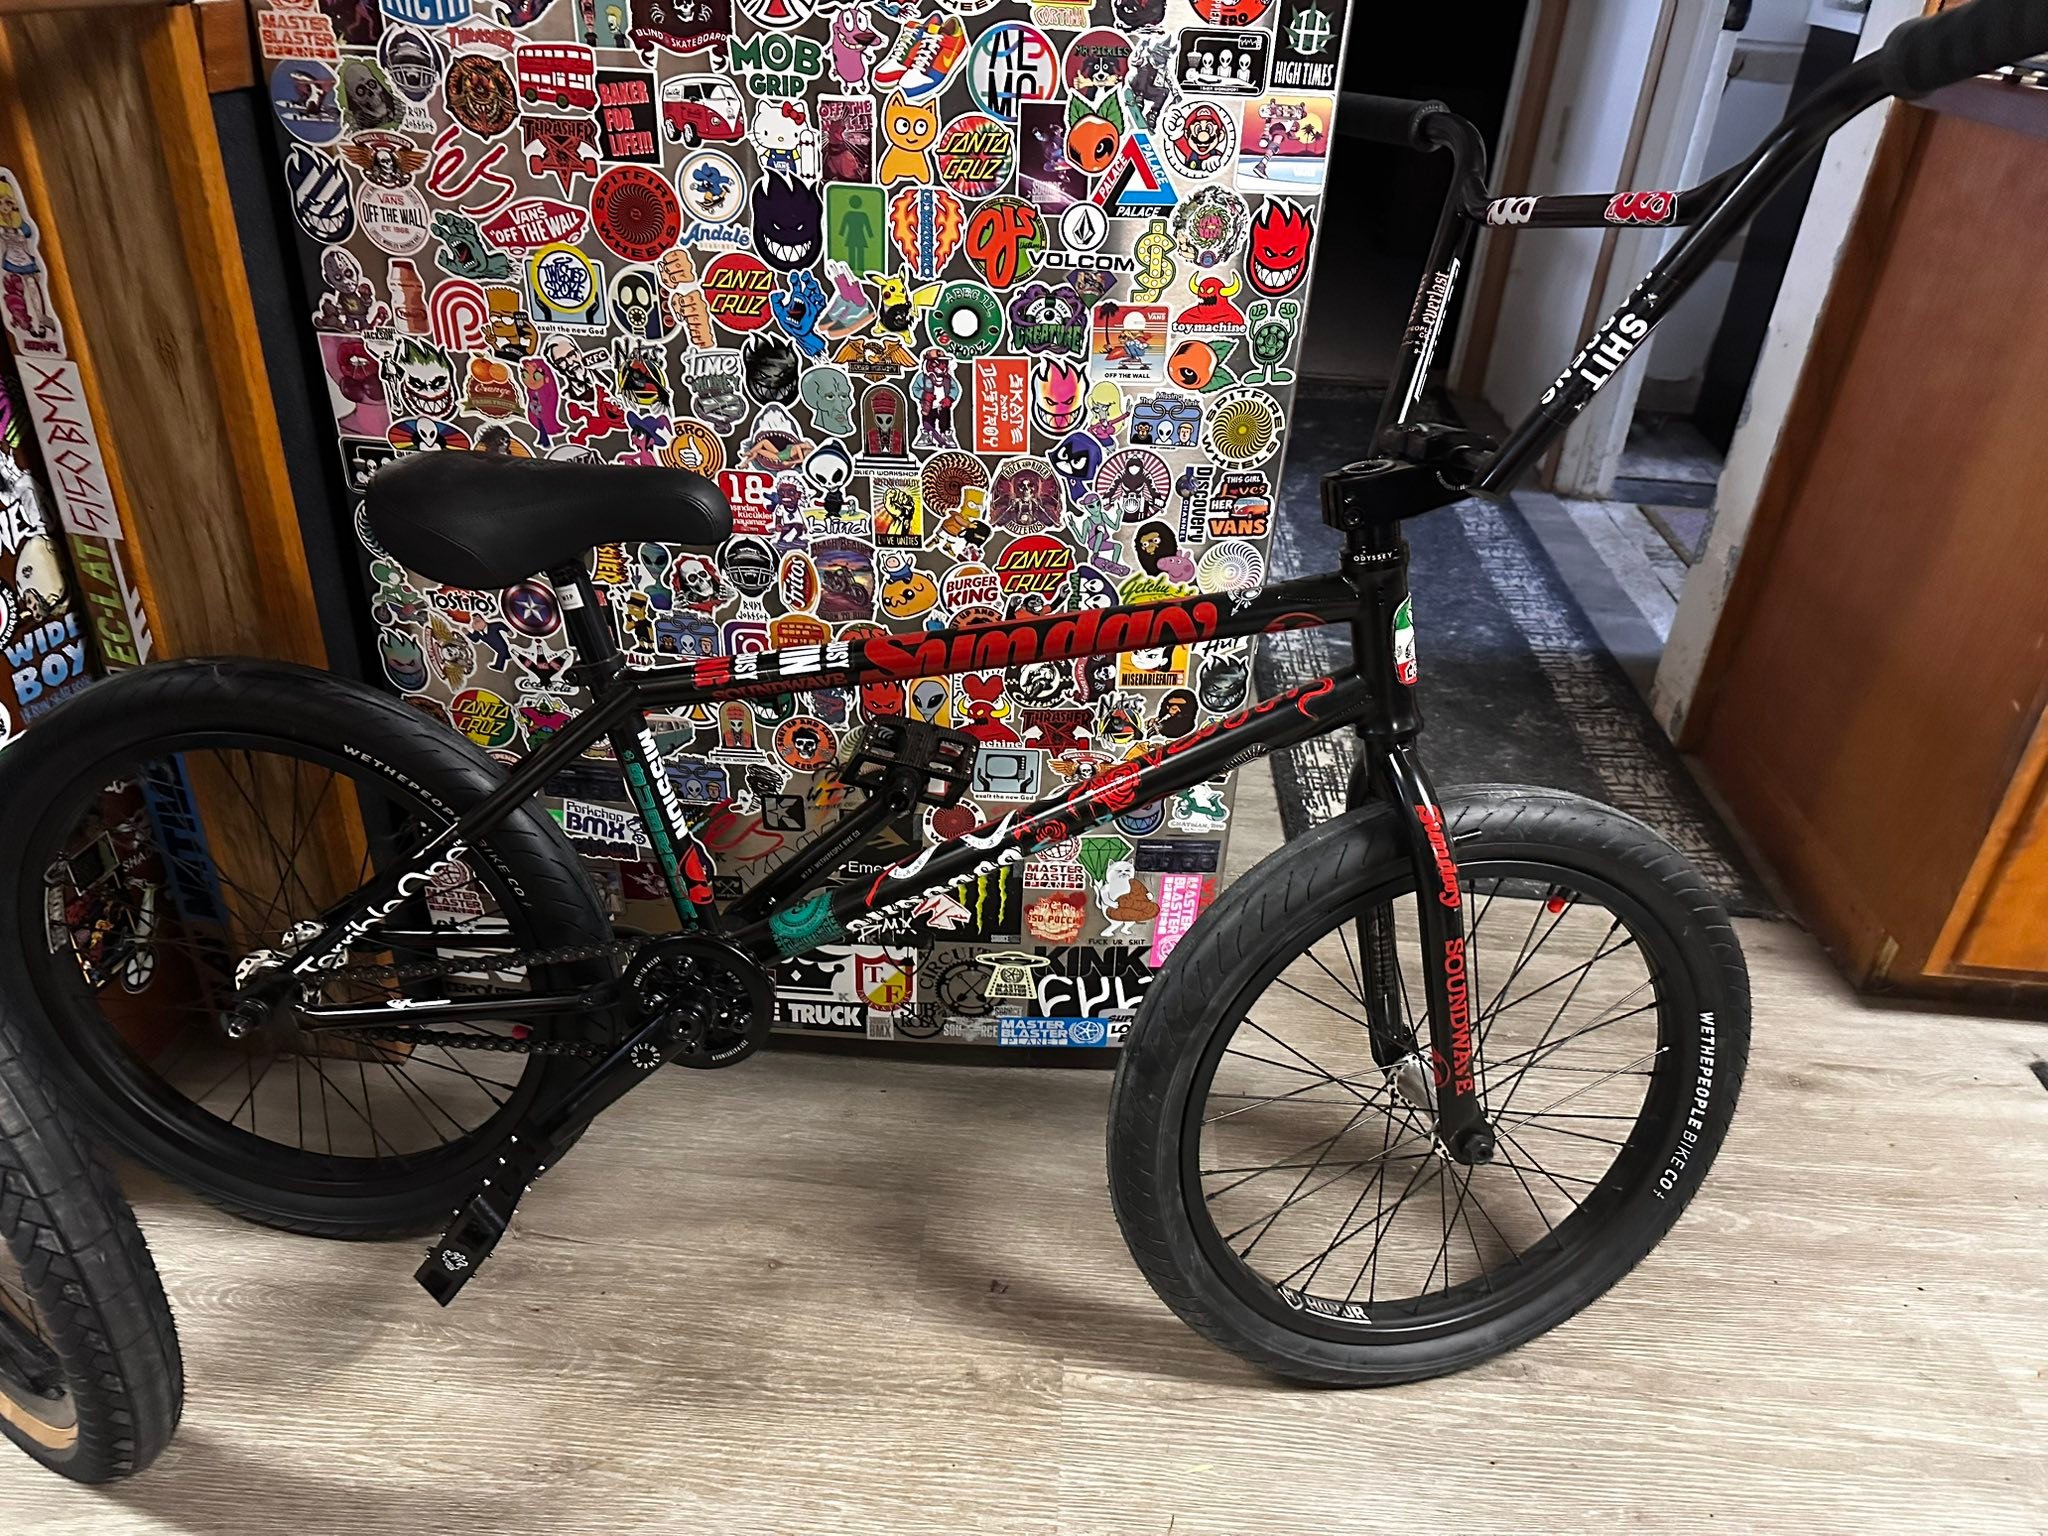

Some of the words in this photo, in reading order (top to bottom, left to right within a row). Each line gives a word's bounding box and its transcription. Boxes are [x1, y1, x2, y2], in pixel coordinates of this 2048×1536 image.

[261, 14, 331, 31] MASTER
[263, 29, 335, 47] BLASTER
[448, 27, 515, 50] THRASHER
[636, 29, 663, 40] BLIND
[731, 34, 822, 76] MOB
[1075, 45, 1089, 57] MR
[1092, 46, 1130, 57] PICKLES
[750, 73, 806, 97] GRIP
[1274, 60, 1302, 85] HIGH
[1303, 61, 1334, 87] TIMES
[601, 80, 649, 106] BAKER
[604, 107, 635, 132] FOR
[819, 102, 842, 118] OFF
[849, 100, 873, 117] THE
[521, 117, 597, 149] THRASHER
[609, 131, 654, 157] LIFE!!!
[937, 132, 1011, 154] SANTA
[943, 159, 1003, 180] CRUZ
[1141, 142, 1169, 186] PALACE
[1099, 153, 1128, 199] PALACE
[377, 194, 405, 206] VANS
[596, 170, 677, 215] SPITFIRE
[362, 202, 379, 223] OFF
[380, 204, 399, 223] THE
[400, 207, 426, 229] WALL
[508, 202, 548, 225] VANS
[1116, 206, 1160, 217] PALACE
[517, 220, 550, 243] THE
[545, 211, 581, 239] WALL
[681, 223, 750, 247] Andalé
[601, 223, 677, 258] WHEELS
[1030, 250, 1135, 273] VOLCOM
[702, 269, 776, 290] SANTA
[710, 294, 771, 316] CRUZ
[945, 288, 980, 304] ABEC
[1422, 270, 1450, 326] everlast
[1147, 312, 1166, 321] VANS
[363, 331, 394, 342] JACKSON
[537, 325, 556, 333] exalt
[557, 325, 570, 333] the
[588, 327, 605, 336] God
[1014, 323, 1084, 353] CREATURE
[585, 351, 607, 367] KFC
[1580, 313, 1648, 392] SHIT
[475, 383, 512, 399] Orange
[1156, 391, 1184, 401] Missing
[978, 363, 999, 447] DESTROY
[1009, 374, 1024, 444] SKATE
[1205, 389, 1283, 430] SPITFIRE
[675, 423, 706, 439] BRO
[1202, 434, 1278, 470] WHEELS
[1006, 462, 1021, 475] ROCK
[1031, 462, 1050, 476] RIDER
[1226, 475, 1244, 483] THIS
[1244, 474, 1261, 483] GIRL
[728, 473, 764, 505] 18
[1212, 499, 1234, 511] HER
[807, 515, 868, 536] blind
[1007, 520, 1043, 536] MOTEROS
[1179, 499, 1190, 543] CHANNEL
[1210, 519, 1267, 536] VANS
[896, 536, 920, 546] UNITES
[996, 548, 1071, 571] SANTA
[1353, 551, 1393, 562] ODYSSEY
[783, 555, 807, 608] Fritos
[946, 576, 998, 593] BURGER
[1003, 571, 1064, 593] CRUZ
[948, 587, 999, 608] KING
[974, 607, 996, 618] AND
[4, 611, 83, 669] WIDE
[12, 637, 87, 705] BOY
[1121, 672, 1178, 687] MISERABLEFAITH
[712, 671, 848, 701] SOUNDWAVE
[450, 699, 511, 720] SANTA
[459, 717, 506, 736] CRUZ
[1023, 709, 1095, 735] THRASHER
[776, 727, 786, 750] SHUT
[801, 718, 819, 726] AND
[820, 724, 835, 750] SKATE
[980, 739, 1023, 749] achine
[343, 744, 463, 823] WETHEPEOP
[1020, 793, 1034, 801] God
[566, 800, 624, 823] Porkchop
[566, 815, 626, 841] BMX
[1414, 803, 1460, 909] Sunday
[1025, 872, 1085, 882] BLASTER
[1026, 863, 1084, 873] MASTER
[1166, 876, 1187, 935] BLASTER
[1181, 876, 1198, 933] MASTER
[1088, 938, 1109, 946] FUCK
[1129, 938, 1146, 946] SHIT
[919, 947, 992, 990] CIRCUIT
[1034, 945, 1154, 978] KINK
[788, 1003, 862, 1027] TRUCK
[901, 1001, 933, 1015] SUB
[1444, 937, 1474, 1097] SOUNDWAVE
[901, 1015, 938, 1028] ROSA
[1002, 1020, 1065, 1029] MASTER
[1001, 1029, 1069, 1039] BLASTER
[1686, 1011, 1716, 1131] WETHEPEOPLE
[1670, 1130, 1699, 1170] BIKE
[1658, 1169, 1679, 1191] CO
